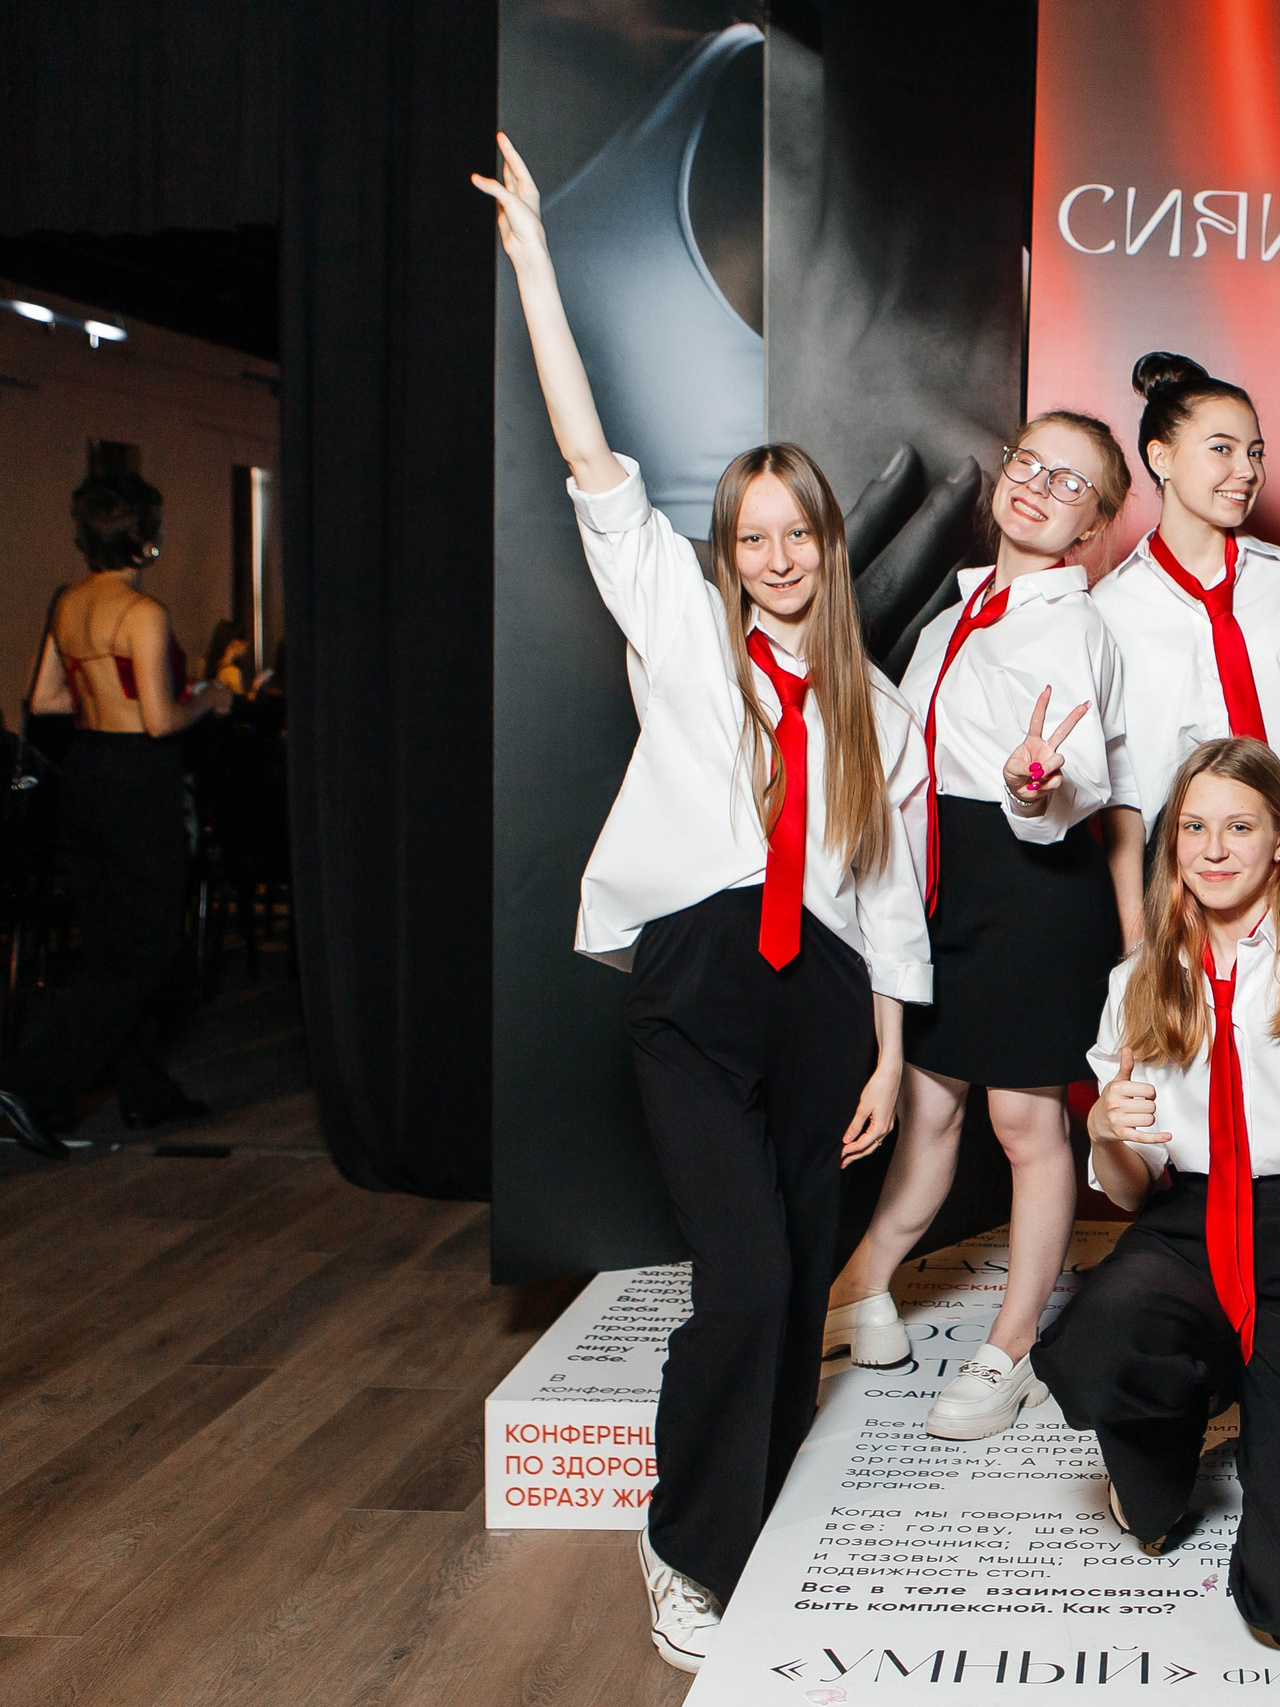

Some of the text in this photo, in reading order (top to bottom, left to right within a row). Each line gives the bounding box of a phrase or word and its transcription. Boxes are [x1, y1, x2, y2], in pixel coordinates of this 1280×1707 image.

[624, 1287, 690, 1296] снару
[616, 1295, 646, 1303] Вы
[608, 1305, 659, 1313] себя
[901, 1300, 965, 1310] МОДА
[593, 1324, 673, 1333] проявл
[584, 1334, 668, 1342] показы
[575, 1344, 635, 1353] миру
[567, 1354, 627, 1363] себе.
[549, 1373, 567, 1382] В
[540, 1385, 661, 1396] конферен
[864, 1389, 942, 1399] ОСАН
[865, 1418, 906, 1429] Все
[855, 1443, 968, 1455] суставы,
[986, 1446, 1100, 1455] распред
[506, 1455, 658, 1479] ПО ЗДОРОВ
[851, 1455, 1002, 1468] организму.
[1020, 1457, 1037, 1466] А
[1055, 1459, 1107, 1467] так
[845, 1468, 960, 1478] здоровое
[971, 1470, 1111, 1480] расположен
[841, 1480, 946, 1490] органов.
[505, 1486, 653, 1508] ОБРАЗУ ЖИ
[830, 1506, 902, 1519] Когда
[914, 1510, 948, 1518] мы
[961, 1511, 1063, 1522] говорим
[824, 1522, 885, 1532] все:
[905, 1524, 1013, 1536] голову,
[1035, 1526, 1099, 1535] шею
[819, 1537, 1011, 1550] позвоночника;
[1029, 1539, 1122, 1552] работу
[813, 1552, 829, 1560] и
[848, 1553, 960, 1563] тазовых
[978, 1555, 1064, 1567] мышц;
[1083, 1555, 1181, 1568] работу
[806, 1566, 1052, 1578] подвижность стоп.
[800, 1581, 852, 1594] Все
[870, 1585, 885, 1594] в
[904, 1586, 967, 1596] теле
[986, 1587, 1206, 1598] взаимосвязано.
[794, 1598, 1177, 1615] быть комплексной. Как это?
